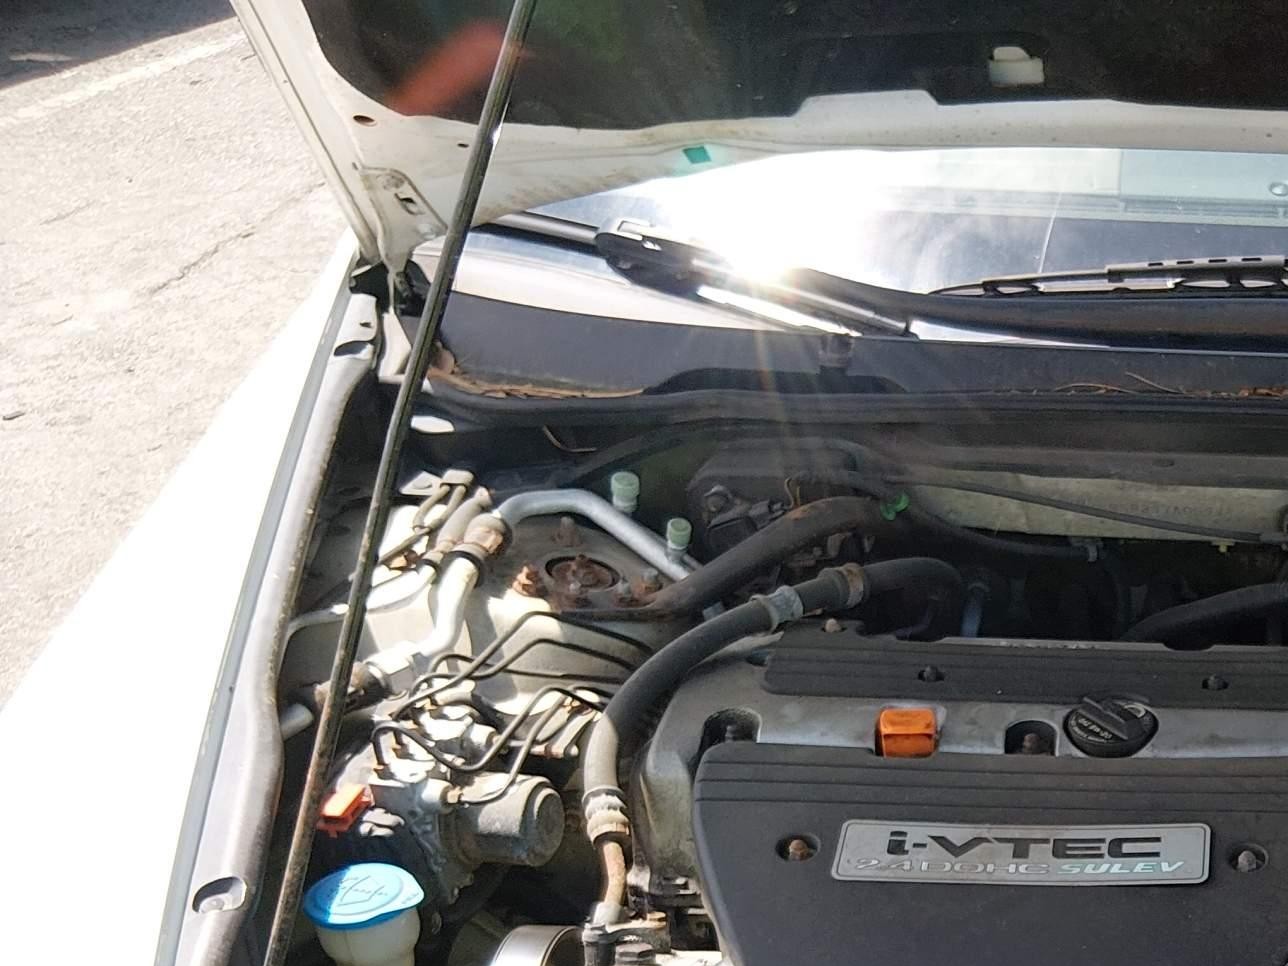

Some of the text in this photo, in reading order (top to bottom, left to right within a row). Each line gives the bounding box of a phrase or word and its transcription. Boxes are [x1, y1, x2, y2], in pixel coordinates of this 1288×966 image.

[887, 831, 1161, 859] i-VTEC
[921, 861, 1050, 875] DOHC
[1056, 861, 1185, 875] SULEV
